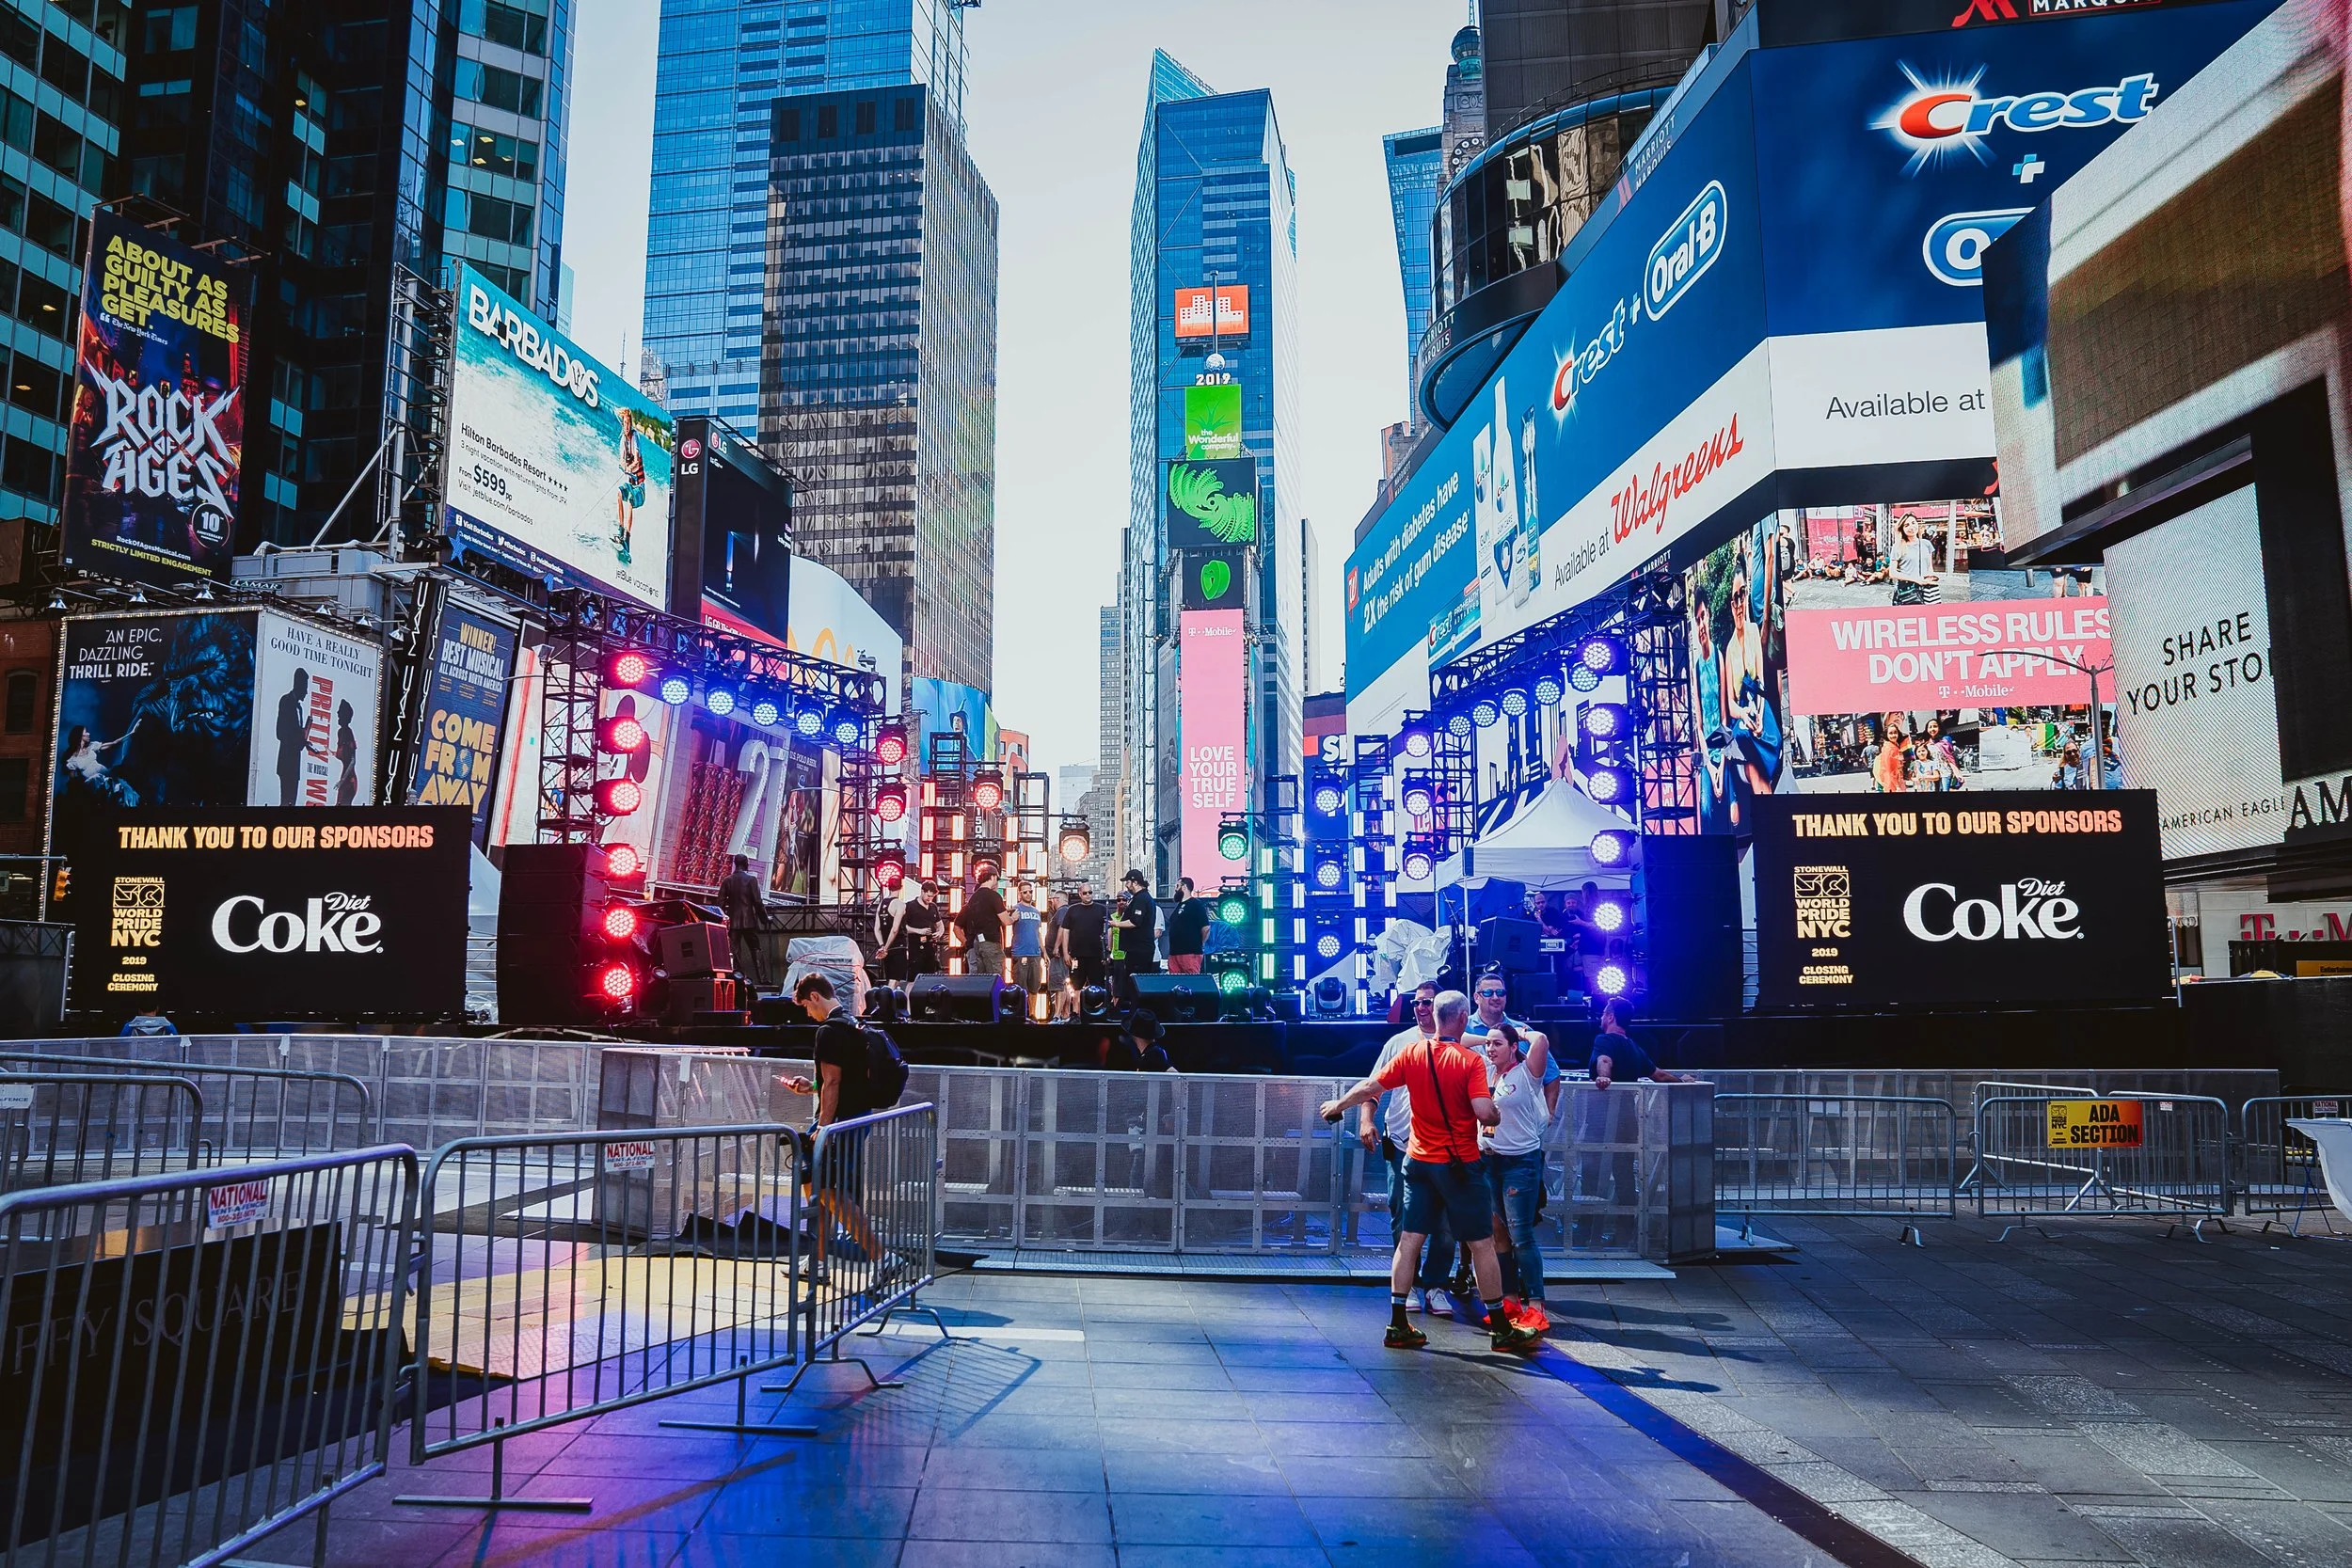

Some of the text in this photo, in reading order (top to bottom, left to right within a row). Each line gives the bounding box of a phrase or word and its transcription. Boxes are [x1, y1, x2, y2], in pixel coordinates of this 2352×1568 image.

[1899, 72, 2159, 140] Crest
[1635, 115, 1675, 174] MARRIOTT
[106, 235, 228, 300] ABOUT AS
[105, 254, 226, 319] GUILTY AS
[103, 272, 239, 343] PLEASURES
[112, 318, 168, 345] The New York Times
[469, 283, 600, 407] BARBADOS
[1554, 298, 1626, 411] Crest
[1196, 372, 1231, 386] 2019
[84, 356, 241, 468] ROCK
[1826, 388, 1985, 420] Available at
[155, 435, 177, 456] OF
[461, 422, 547, 482] Hilton Barbados Resort
[718, 438, 727, 454] LG
[1188, 433, 1239, 444] Wonderful
[102, 444, 234, 519] AGES
[458, 463, 513, 502] From $599 pp
[460, 440, 465, 449] 3
[465, 442, 480, 457] night
[480, 452, 503, 471] vacation
[504, 466, 515, 478] with
[516, 472, 531, 486] return
[532, 480, 547, 495] flights
[548, 488, 558, 500] from
[681, 463, 699, 475] LG
[1476, 465, 1489, 484] Crest
[1611, 412, 1744, 545] Walgreens
[1497, 480, 1510, 498] Crest
[472, 486, 533, 525] jetblue.com/barbados
[473, 526, 494, 541] Barbados
[1363, 560, 1383, 594] Adults
[1385, 535, 1400, 570] with
[1402, 498, 1435, 551] diabetes
[1437, 471, 1459, 511] have
[91, 538, 212, 577] STRICTLY LIMITED ENGAGEMENT
[116, 535, 191, 561] RockOfAgesMusical.com
[1554, 536, 1597, 591] Available
[1598, 529, 1610, 556] at
[233, 580, 278, 589] LAMAR
[1363, 596, 1376, 634] 2X
[1377, 592, 1389, 621] the
[1390, 575, 1404, 609] risk
[1405, 562, 1413, 593] of
[1414, 551, 1431, 588] gum
[129, 627, 163, 644] EPIC,
[460, 622, 497, 655] WINNER!
[1429, 610, 1453, 647] Crest
[1830, 609, 2110, 651] WIRELESS RULES
[2163, 611, 2251, 666] SHARE
[79, 646, 144, 662] DAZZLING
[287, 626, 361, 659] HAVE A REALLY
[70, 663, 113, 679] THRILL
[270, 637, 373, 678] GOOD TIME TONIGHT
[441, 639, 504, 680] BEST MUSICAL
[1868, 645, 2085, 685] DON'T APPLY
[438, 662, 448, 675] ALL
[448, 665, 469, 681] ACROSS
[469, 673, 483, 687] NORTH
[483, 676, 502, 693] AMERICA
[2127, 652, 2263, 716] YOUR STO
[308, 674, 334, 763] PRETTY
[431, 708, 496, 753] COME
[1190, 746, 1233, 762] LOVE
[1189, 761, 1237, 778] YOUR
[419, 774, 487, 814] AWAY
[1190, 777, 1236, 793] TRUE
[1192, 792, 1235, 809] SELF
[1792, 810, 2122, 837] THANK YOU TO OUR SPONSORS
[2162, 805, 2233, 831] AMERICAN
[119, 825, 434, 848] THANK YOU TO OUR SPONSORS
[2017, 878, 2066, 897] Diet
[113, 909, 163, 918] WORLD
[325, 892, 371, 911] Diet
[1795, 898, 1850, 909] WORLD
[1796, 909, 1851, 921] PRIDE
[1903, 882, 2081, 942] Coke
[112, 918, 162, 929] PRIDE
[212, 895, 382, 953] Coke
[1797, 920, 1851, 938] NYC
[111, 929, 161, 946] NYC
[121, 957, 147, 965] 2019
[1811, 948, 1838, 957] 2019
[112, 974, 154, 982] CLOSING
[1799, 974, 1853, 984] CEREMONY
[1803, 966, 1849, 975] CLOSING
[107, 982, 158, 991] CEREMONY
[2089, 1104, 2121, 1123] ADA
[2070, 1125, 2139, 1144] SECTION
[607, 1141, 653, 1158] NATIONAL
[211, 1180, 267, 1210] NATIONAL
[133, 1270, 301, 1347] SQUARE
